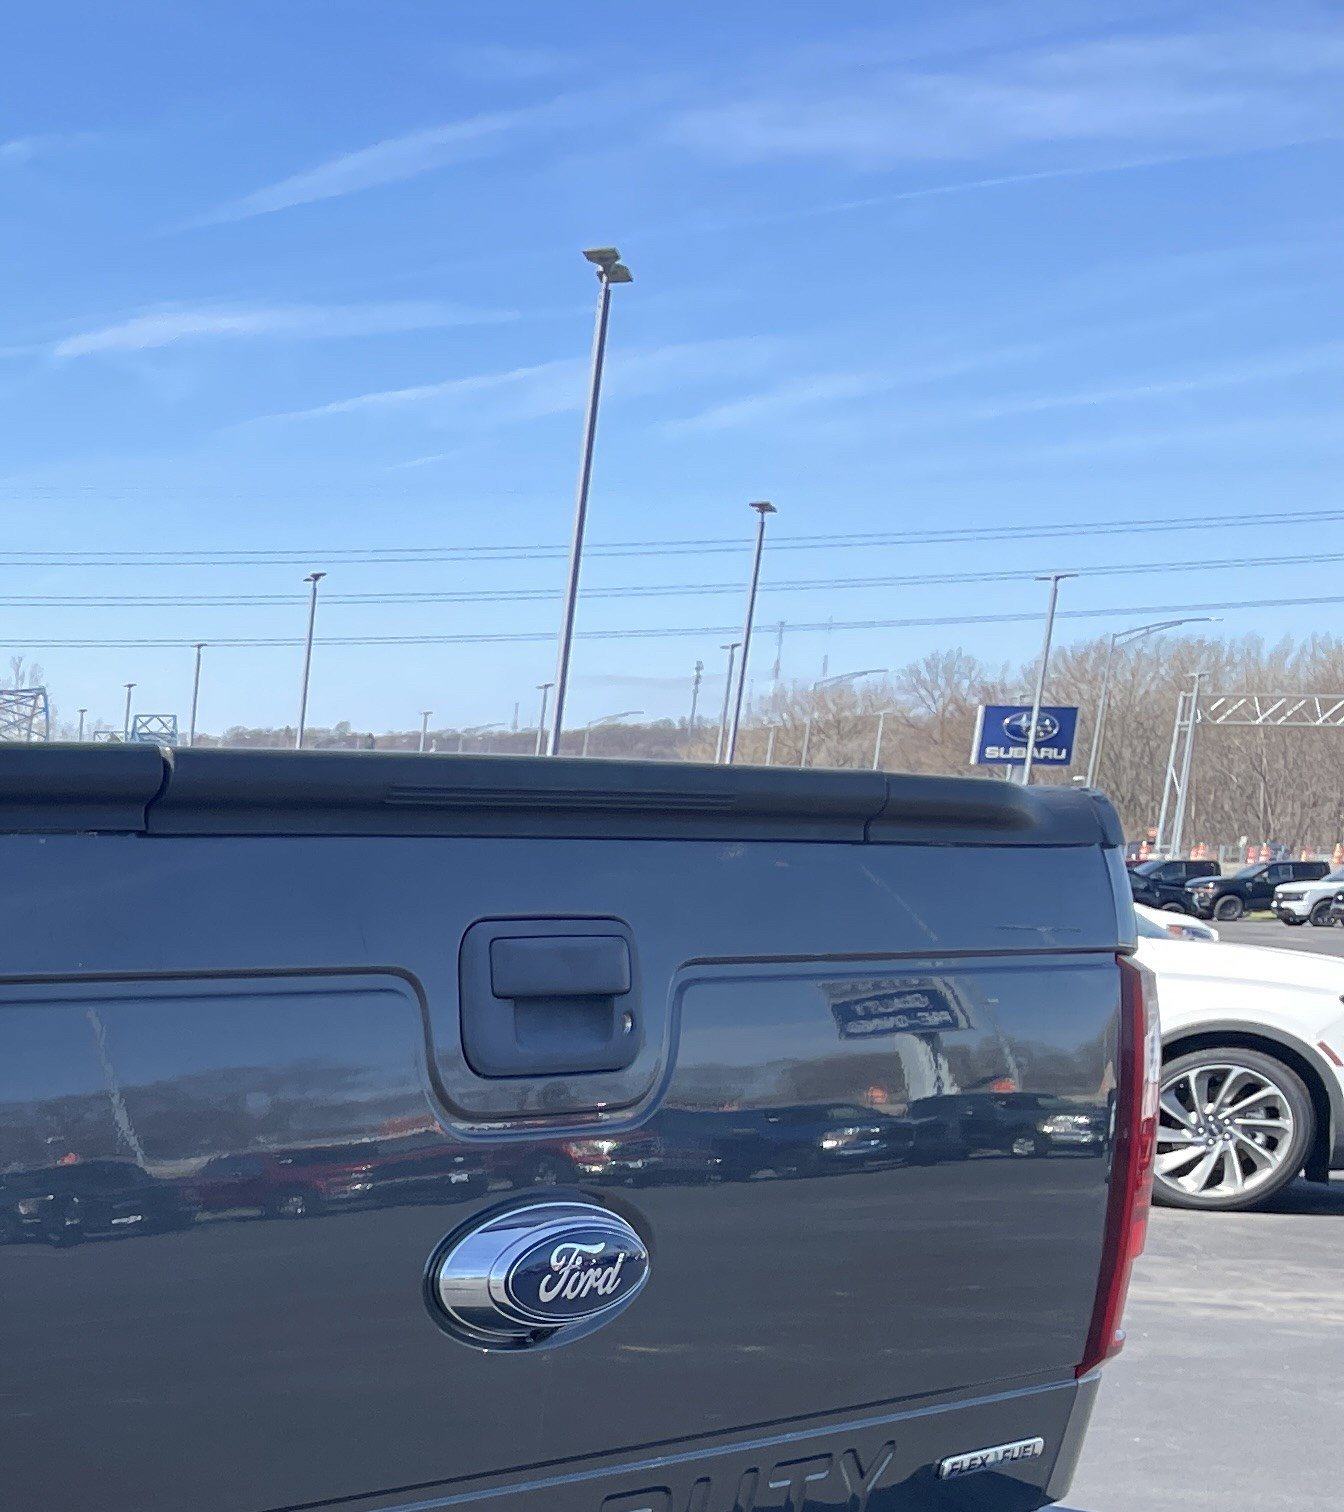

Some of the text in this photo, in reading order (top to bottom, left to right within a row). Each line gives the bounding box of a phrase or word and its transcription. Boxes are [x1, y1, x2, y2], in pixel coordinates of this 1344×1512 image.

[538, 1242, 626, 1303] Ford
[947, 1441, 1041, 1476] FLEX FUEL
